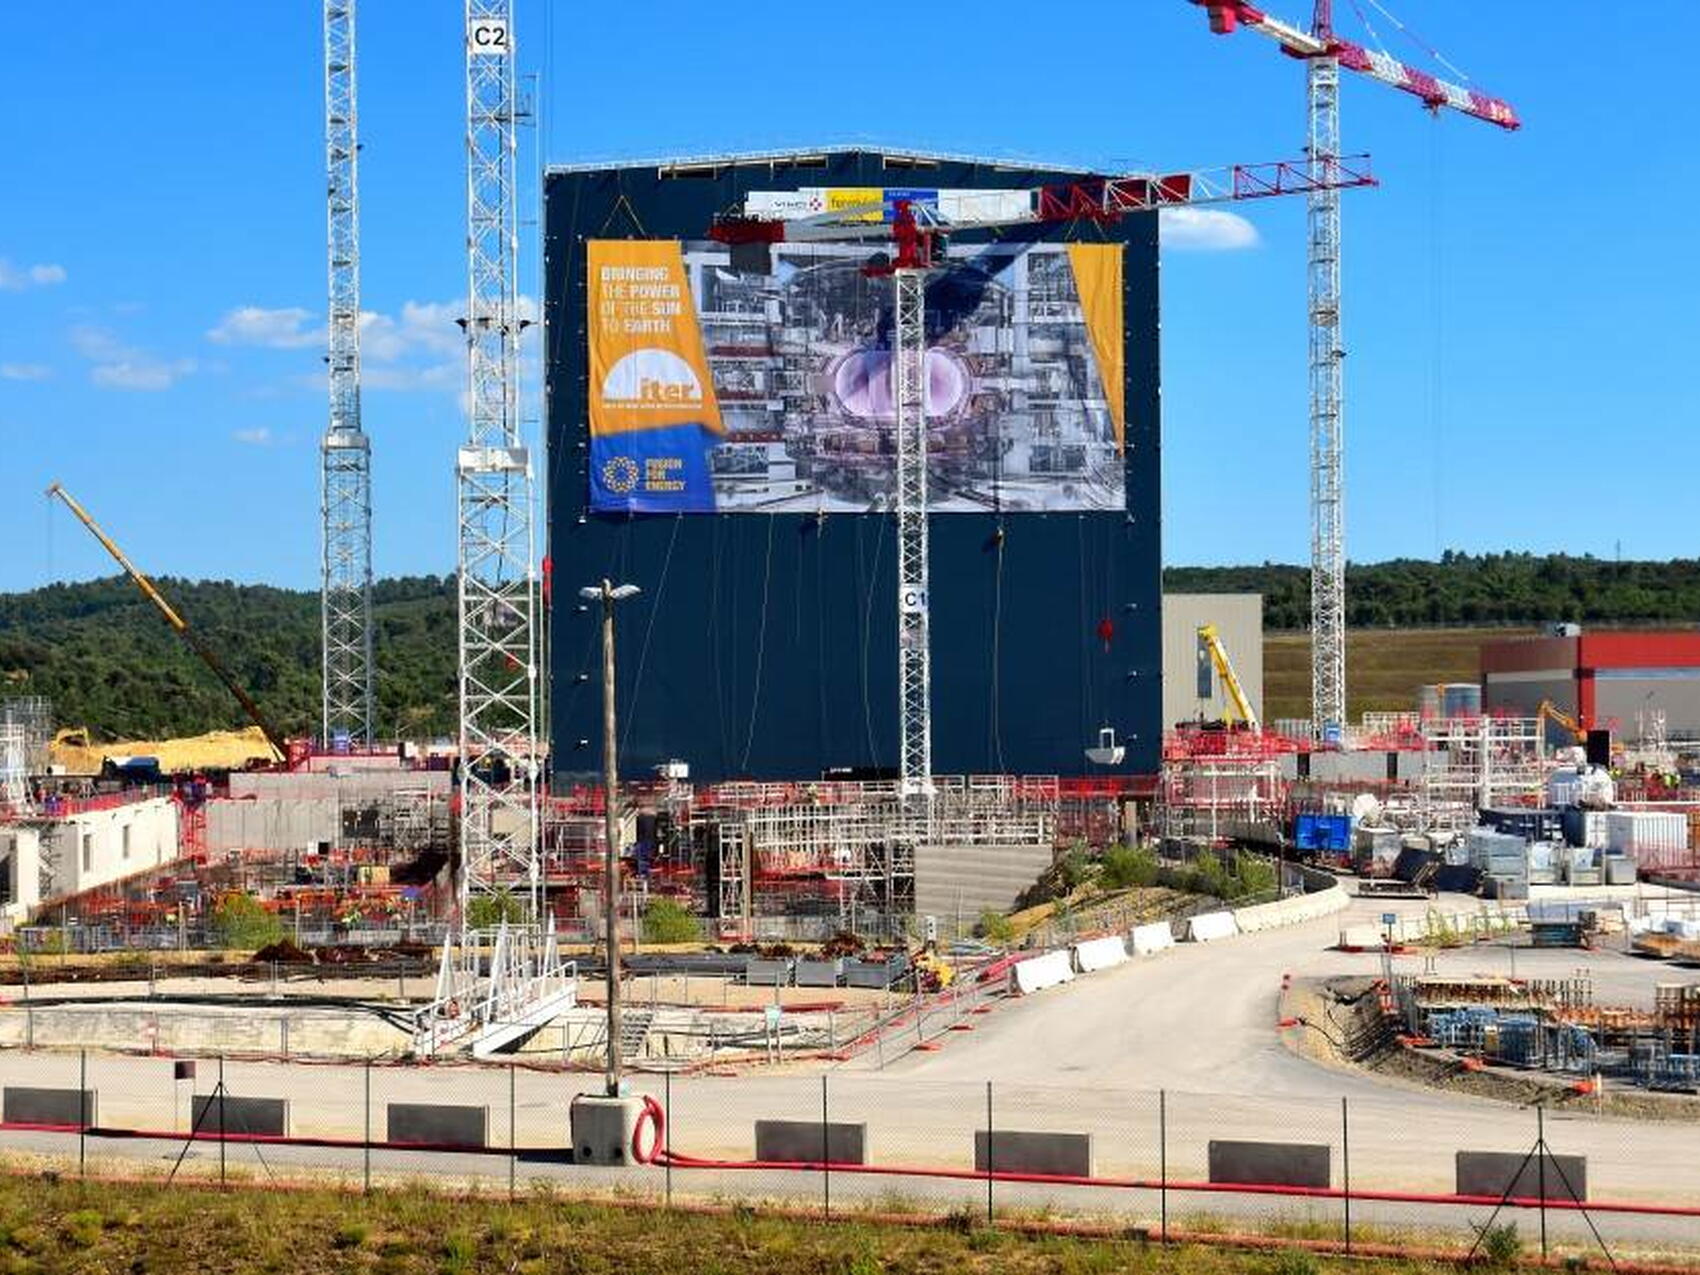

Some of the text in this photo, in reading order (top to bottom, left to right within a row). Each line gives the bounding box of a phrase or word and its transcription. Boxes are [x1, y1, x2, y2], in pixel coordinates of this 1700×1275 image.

[475, 26, 504, 46] C2
[601, 266, 668, 281] BRINGING
[602, 284, 680, 299] THE POWER
[601, 300, 616, 315] OF
[651, 300, 681, 315] SUN
[602, 318, 671, 333] TO EARTH
[640, 378, 694, 400] iter
[905, 591, 925, 607] C1
